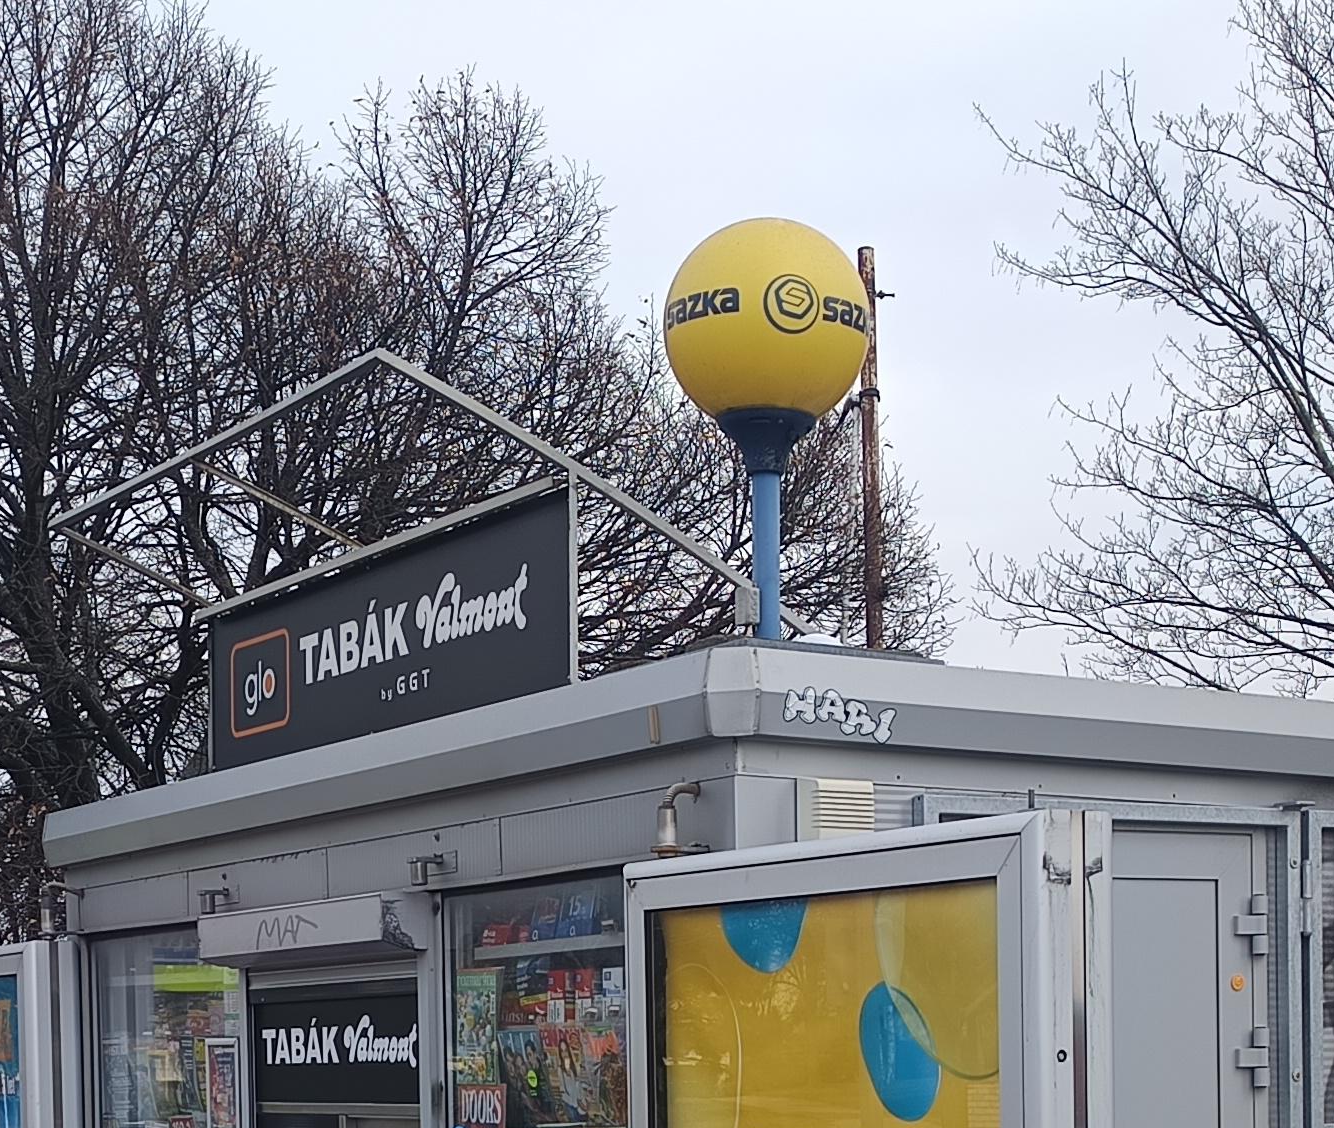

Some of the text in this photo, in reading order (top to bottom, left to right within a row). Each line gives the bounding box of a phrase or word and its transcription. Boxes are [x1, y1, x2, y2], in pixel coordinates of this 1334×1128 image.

[667, 287, 740, 331] sazka
[822, 296, 870, 336] saz
[299, 562, 529, 685] TABÁK Valmont
[244, 660, 275, 717] glo
[380, 688, 393, 701] by
[261, 1013, 419, 1069] TABÁK Valmont
[461, 1089, 502, 1124] DOORS
